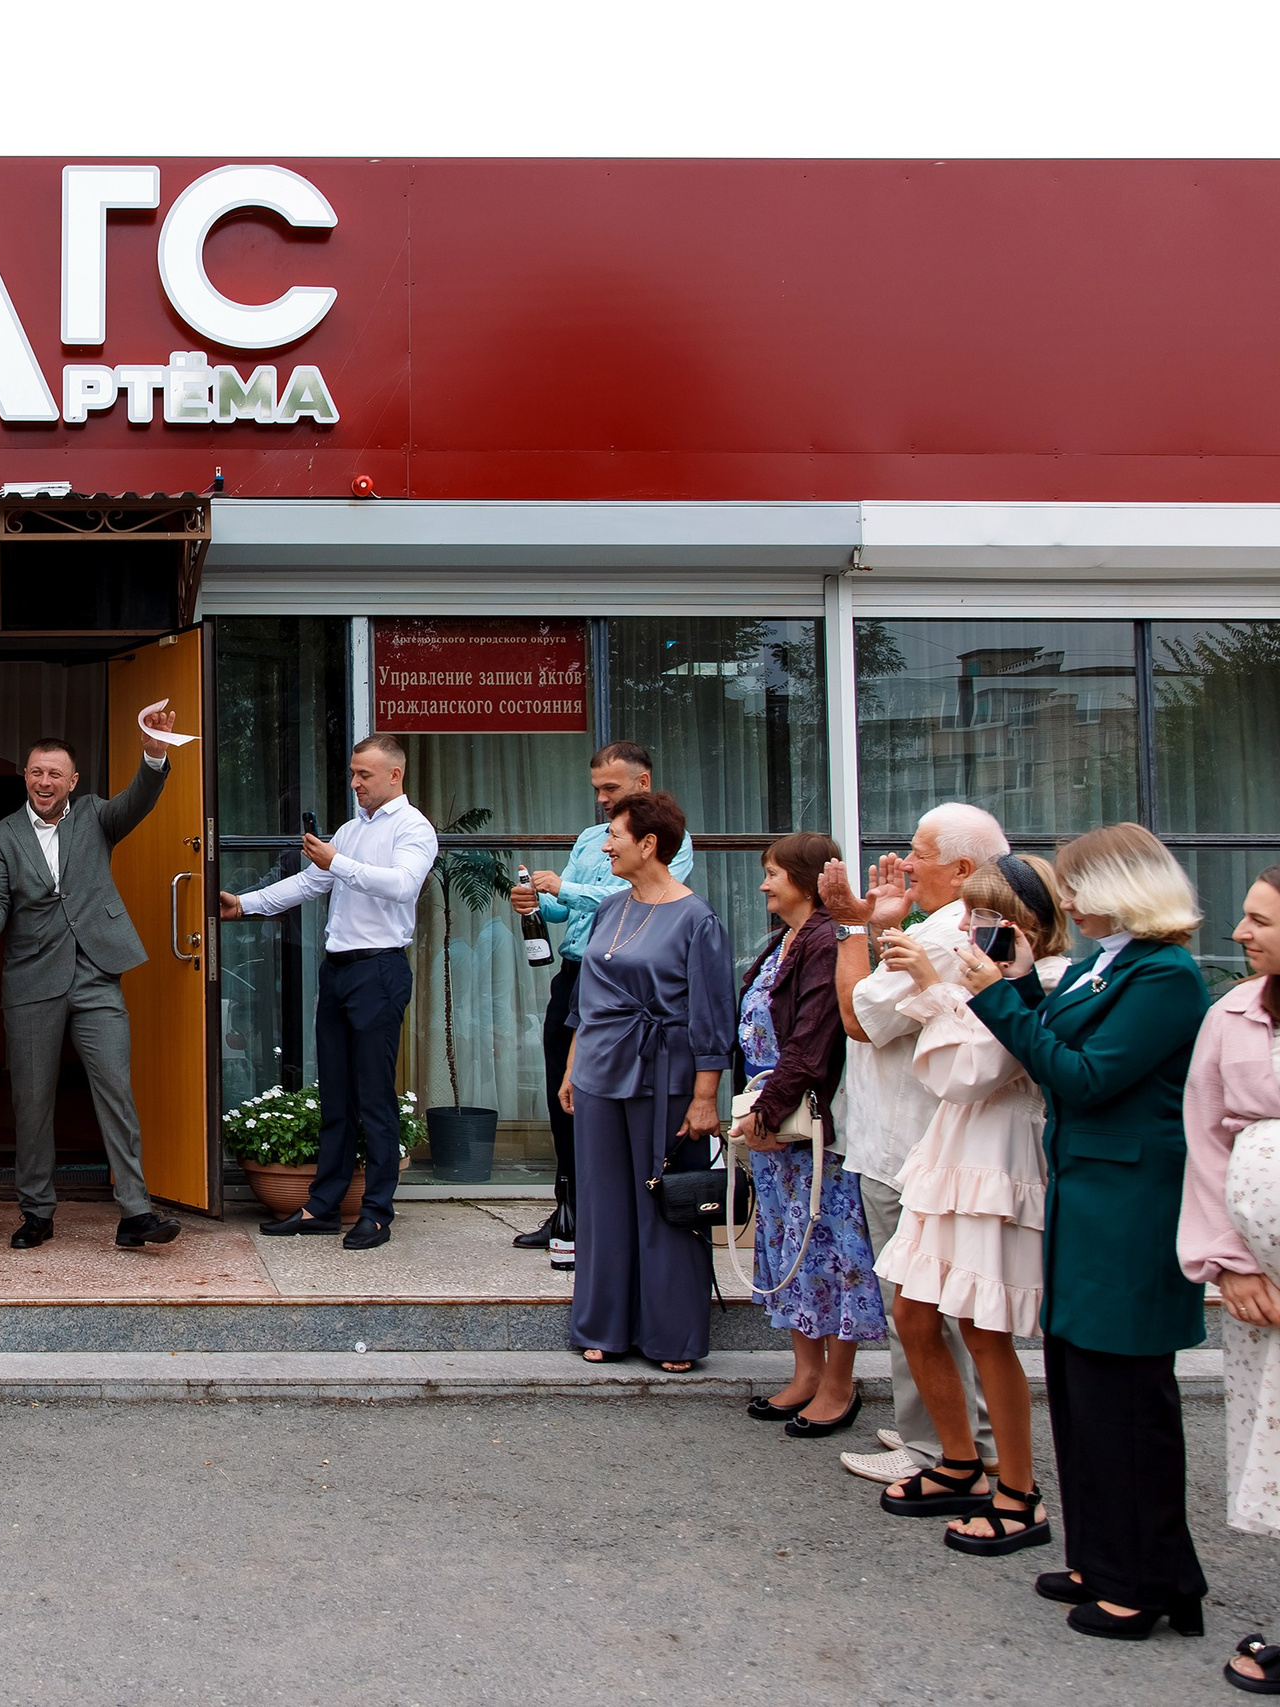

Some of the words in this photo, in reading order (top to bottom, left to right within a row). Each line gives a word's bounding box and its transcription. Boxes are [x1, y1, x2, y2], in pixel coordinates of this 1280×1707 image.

[469, 635, 527, 644] городского
[531, 635, 567, 644] округа
[379, 666, 473, 691] Управление
[478, 671, 533, 685] записи
[539, 671, 582, 685] актов
[379, 699, 493, 719] гражданского
[499, 700, 583, 714] состояния
